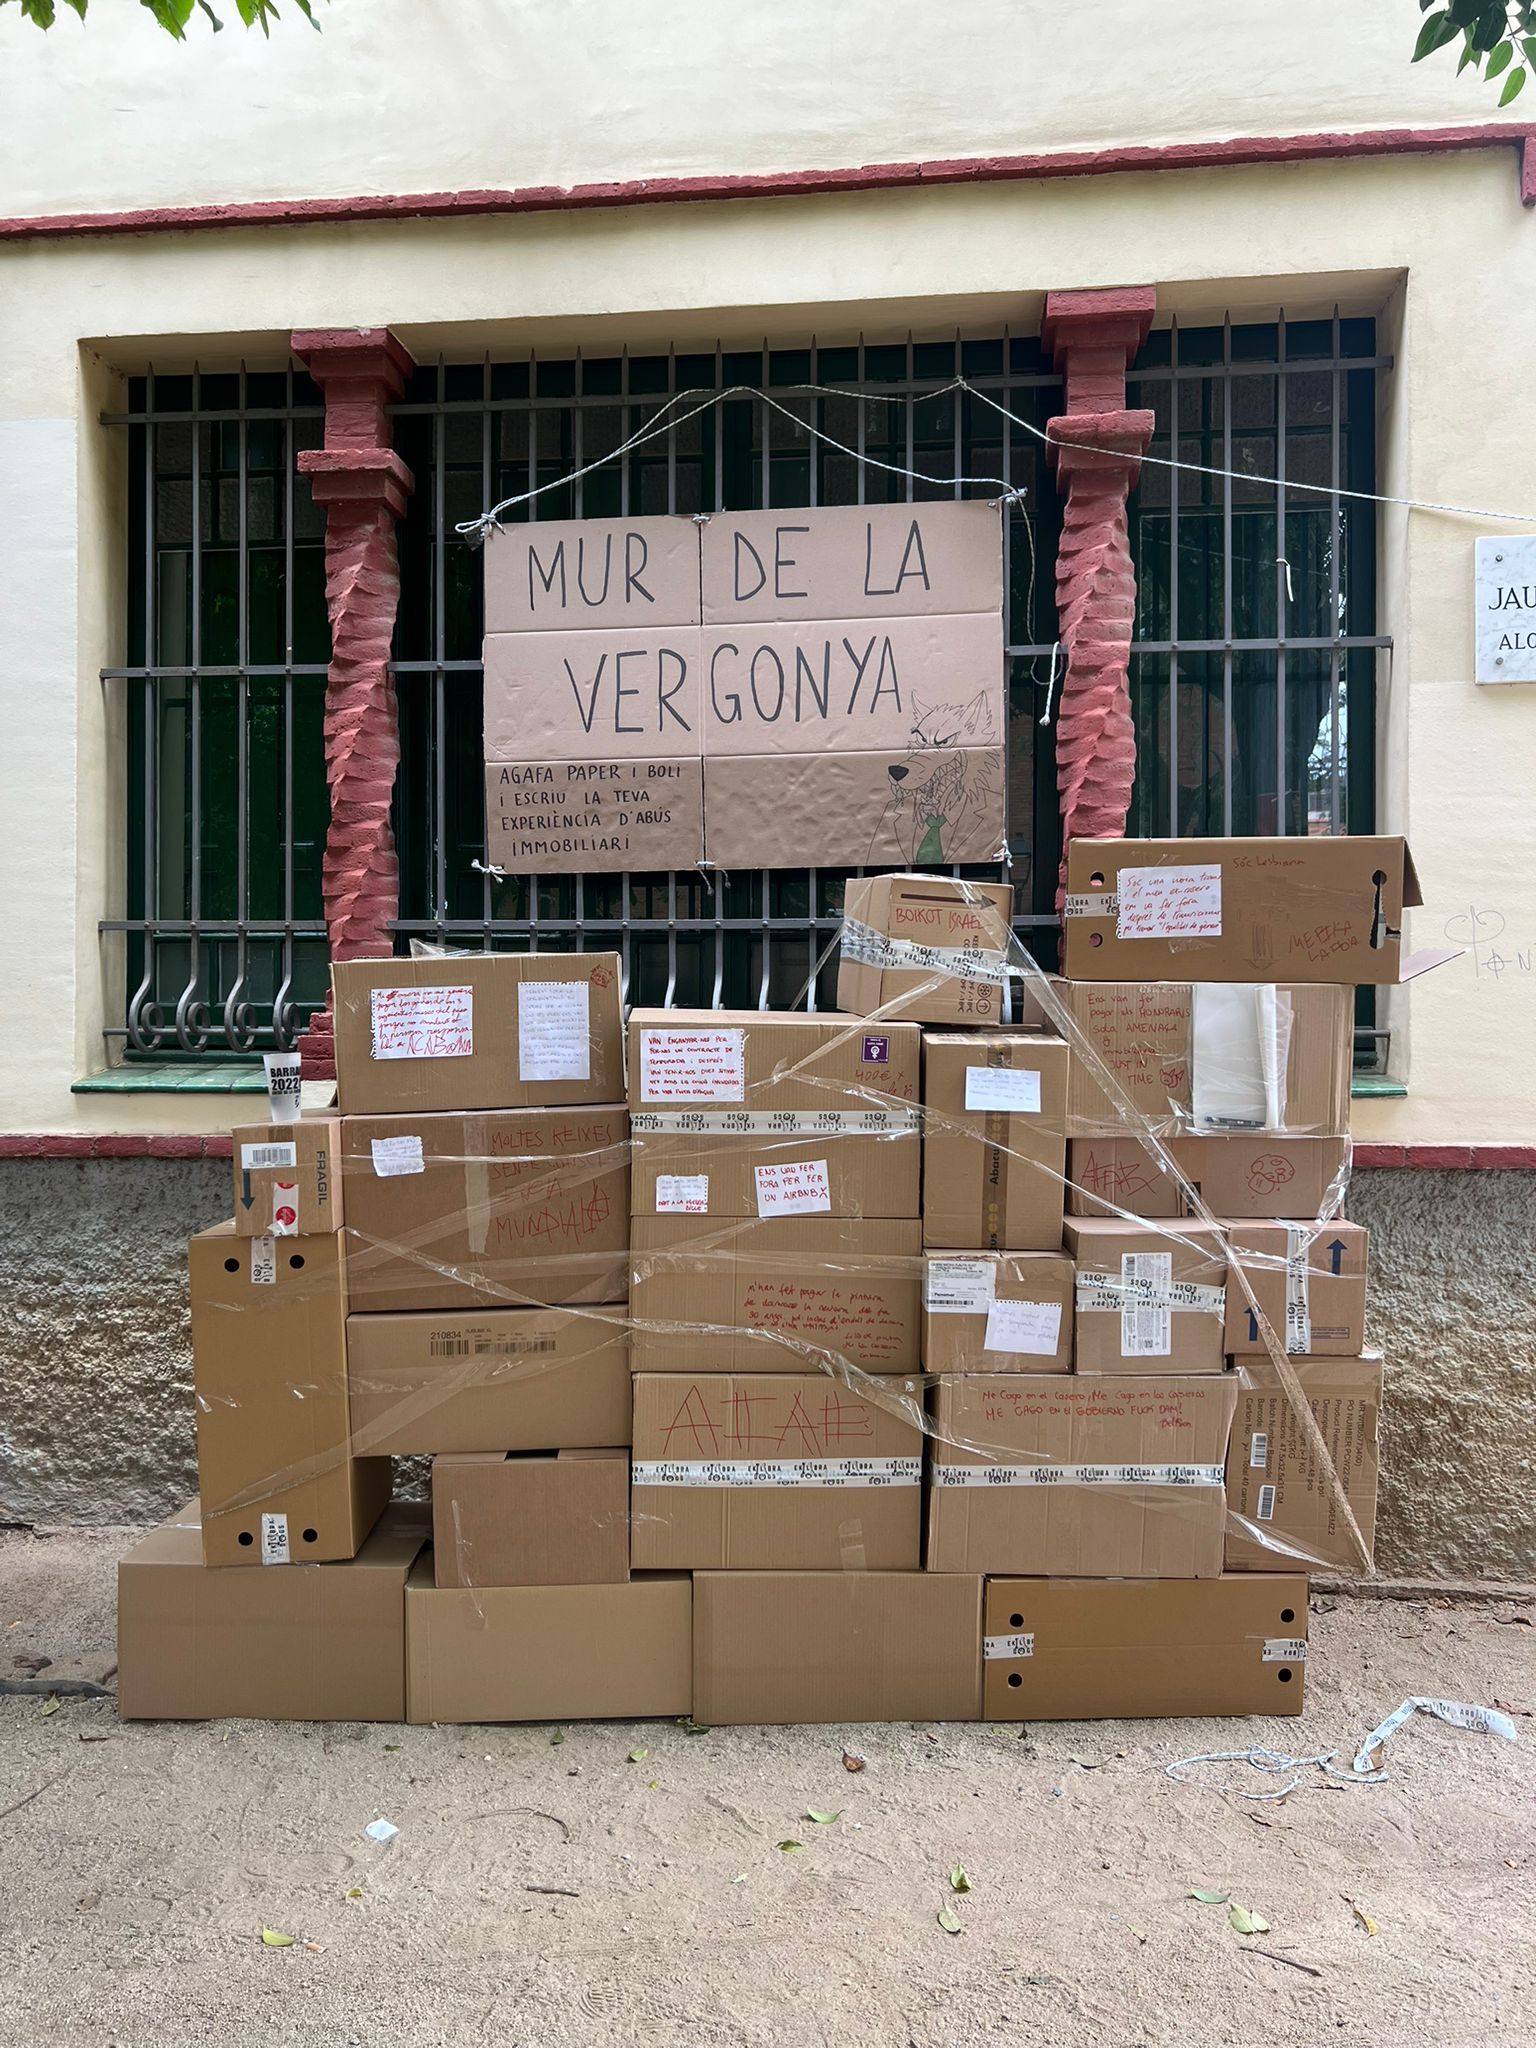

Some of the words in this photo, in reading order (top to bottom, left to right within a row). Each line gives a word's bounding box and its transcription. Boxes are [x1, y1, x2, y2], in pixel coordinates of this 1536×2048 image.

[527, 531, 656, 612] MUR
[733, 524, 811, 601] DE
[864, 519, 931, 596] LA
[563, 634, 903, 733] VERGONYA
[499, 766, 554, 785] AGAFA
[567, 764, 621, 781] PAPER
[515, 791, 566, 806] ESCRIU
[584, 791, 600, 805] LA
[614, 790, 650, 803] TEVA
[502, 810, 601, 831] EXPERIÈNCIA
[619, 806, 672, 826] D'ABÚS
[512, 834, 629, 857] IMMOBILIARI
[1176, 897, 1200, 910] fora
[895, 908, 943, 927] BOIKOT
[948, 911, 994, 933] ISRAEL
[1087, 992, 1105, 1005] Ens
[1110, 995, 1128, 1003] van
[1139, 993, 1154, 1008] fer
[1090, 1009, 1113, 1019] pagar
[1139, 1007, 1191, 1018] HONORARIS
[648, 1037, 662, 1045] VAN
[715, 1035, 728, 1043] PER
[1109, 1060, 1132, 1070] JUST
[1136, 1059, 1148, 1069] IN
[855, 1069, 891, 1081] 400€
[1128, 1074, 1153, 1085] TIME
[271, 1076, 299, 1091] 2022
[316, 1150, 328, 1206] FRAGIL
[758, 1168, 776, 1177] ENS
[799, 1163, 815, 1172] FER
[759, 1180, 779, 1188] FORA
[782, 1176, 800, 1186] PER
[807, 1174, 823, 1183] FER
[764, 1193, 777, 1202] UN
[783, 1188, 818, 1200] AIRBNB
[778, 1283, 795, 1296] fet
[800, 1287, 826, 1300] pagar
[748, 1310, 759, 1319] 30
[430, 1331, 462, 1340] 210834
[982, 1390, 996, 1402] Me
[1000, 1389, 1022, 1405] Cago
[1039, 1391, 1048, 1400] el
[1139, 1392, 1151, 1400] en
[985, 1407, 1003, 1421] ME
[1014, 1405, 1043, 1417] CAGO
[1076, 1405, 1125, 1416] GOBIERNO
[1245, 1398, 1253, 1423] Carton
[1268, 1398, 1277, 1418] Batch
[1334, 1399, 1342, 1427] Product
[1267, 1419, 1276, 1448] Number
[1298, 1462, 1306, 1474] KG
[1276, 1491, 1284, 1504] CM
